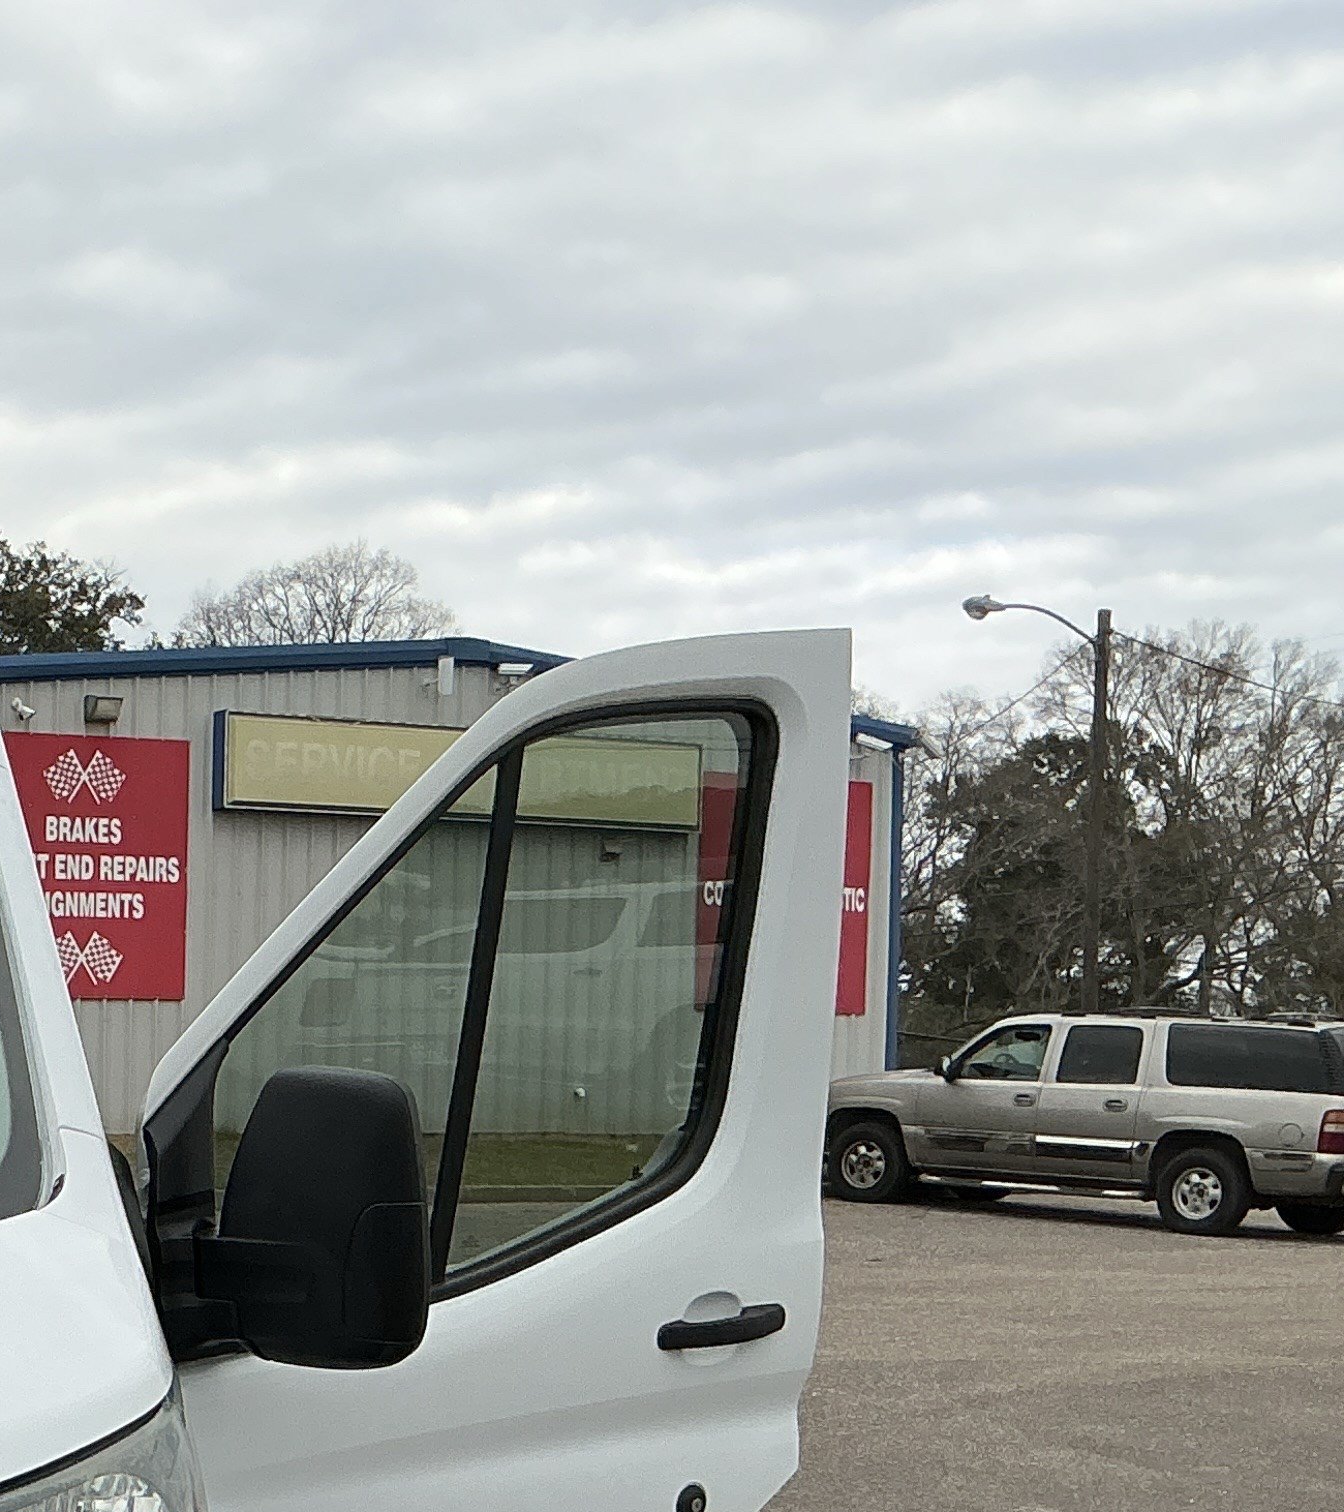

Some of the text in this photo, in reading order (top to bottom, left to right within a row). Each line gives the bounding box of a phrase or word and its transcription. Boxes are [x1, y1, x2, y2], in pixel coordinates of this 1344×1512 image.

[45, 815, 123, 844] BRAKES
[54, 853, 95, 881] END
[99, 855, 181, 883] REPAIRS
[45, 890, 145, 919] IGNMENTS
